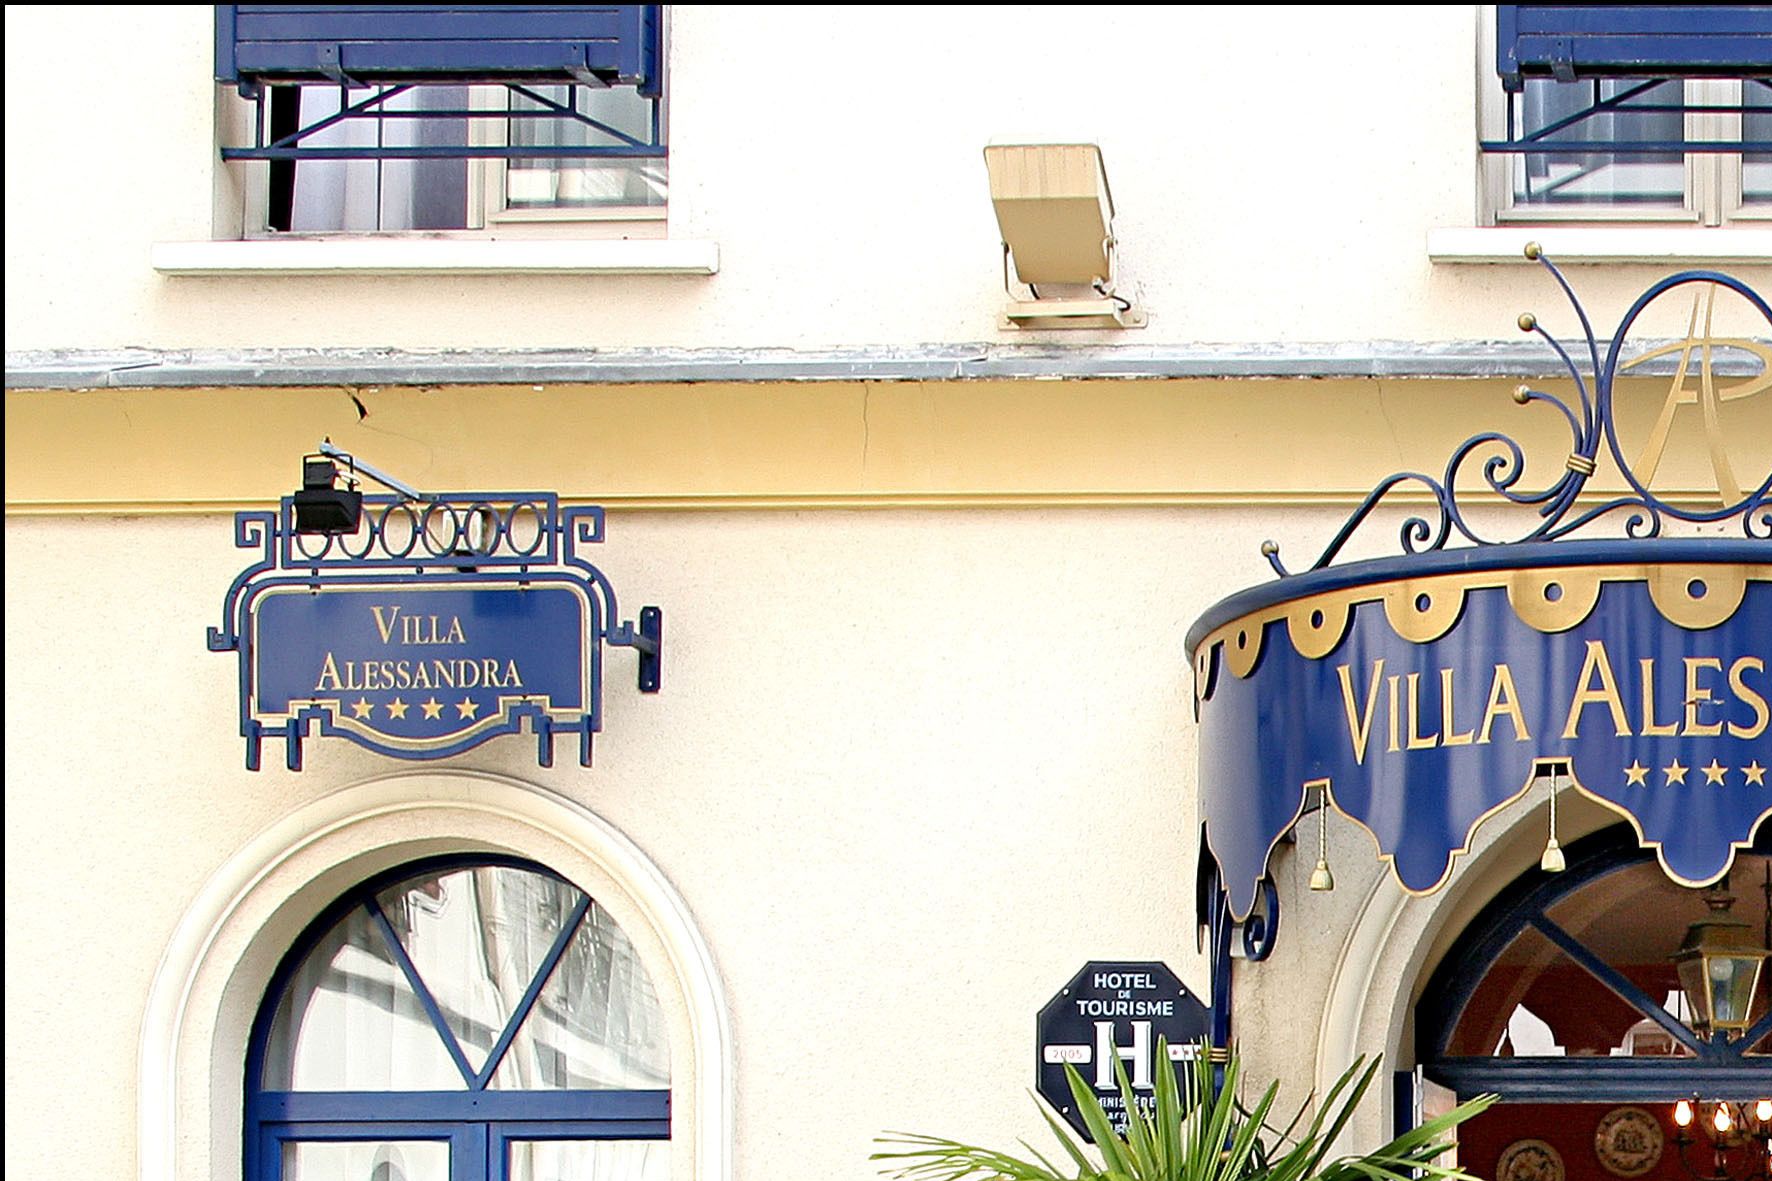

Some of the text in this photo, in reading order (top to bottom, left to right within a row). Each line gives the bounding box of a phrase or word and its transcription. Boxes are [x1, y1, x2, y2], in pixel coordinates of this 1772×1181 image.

[370, 605, 466, 645] VILLA
[314, 651, 524, 692] ALESSANDRA
[1337, 658, 1532, 766] VILLA
[1094, 973, 1157, 989] HOTEL
[1117, 990, 1131, 999] DE
[1076, 1000, 1174, 1016] TOURISME
[1093, 1020, 1154, 1090] H
